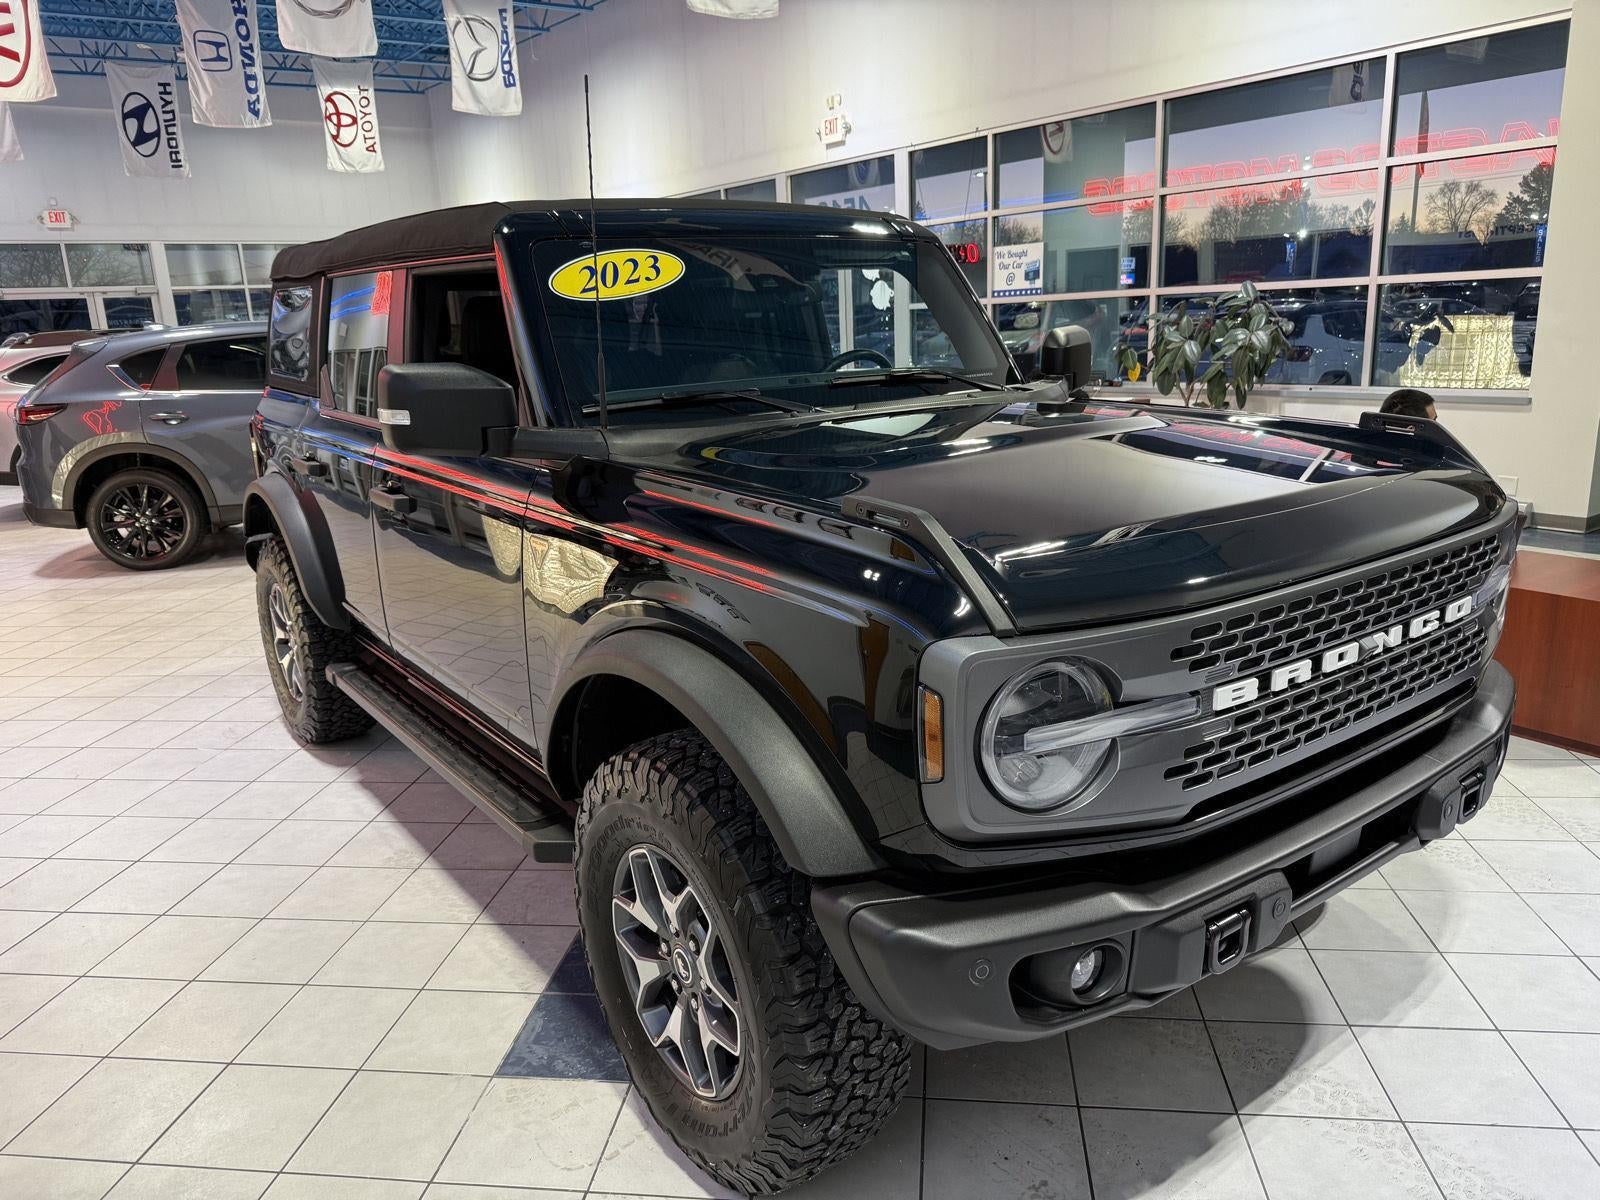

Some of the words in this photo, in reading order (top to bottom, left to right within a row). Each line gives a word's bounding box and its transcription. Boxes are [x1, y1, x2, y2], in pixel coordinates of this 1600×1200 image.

[824, 117, 838, 136] EXIT
[48, 211, 66, 223] EXIT
[578, 254, 661, 294] 2023
[998, 261, 1010, 271] Our
[1012, 261, 1023, 270] Car
[1213, 596, 1472, 711] BRONCO
